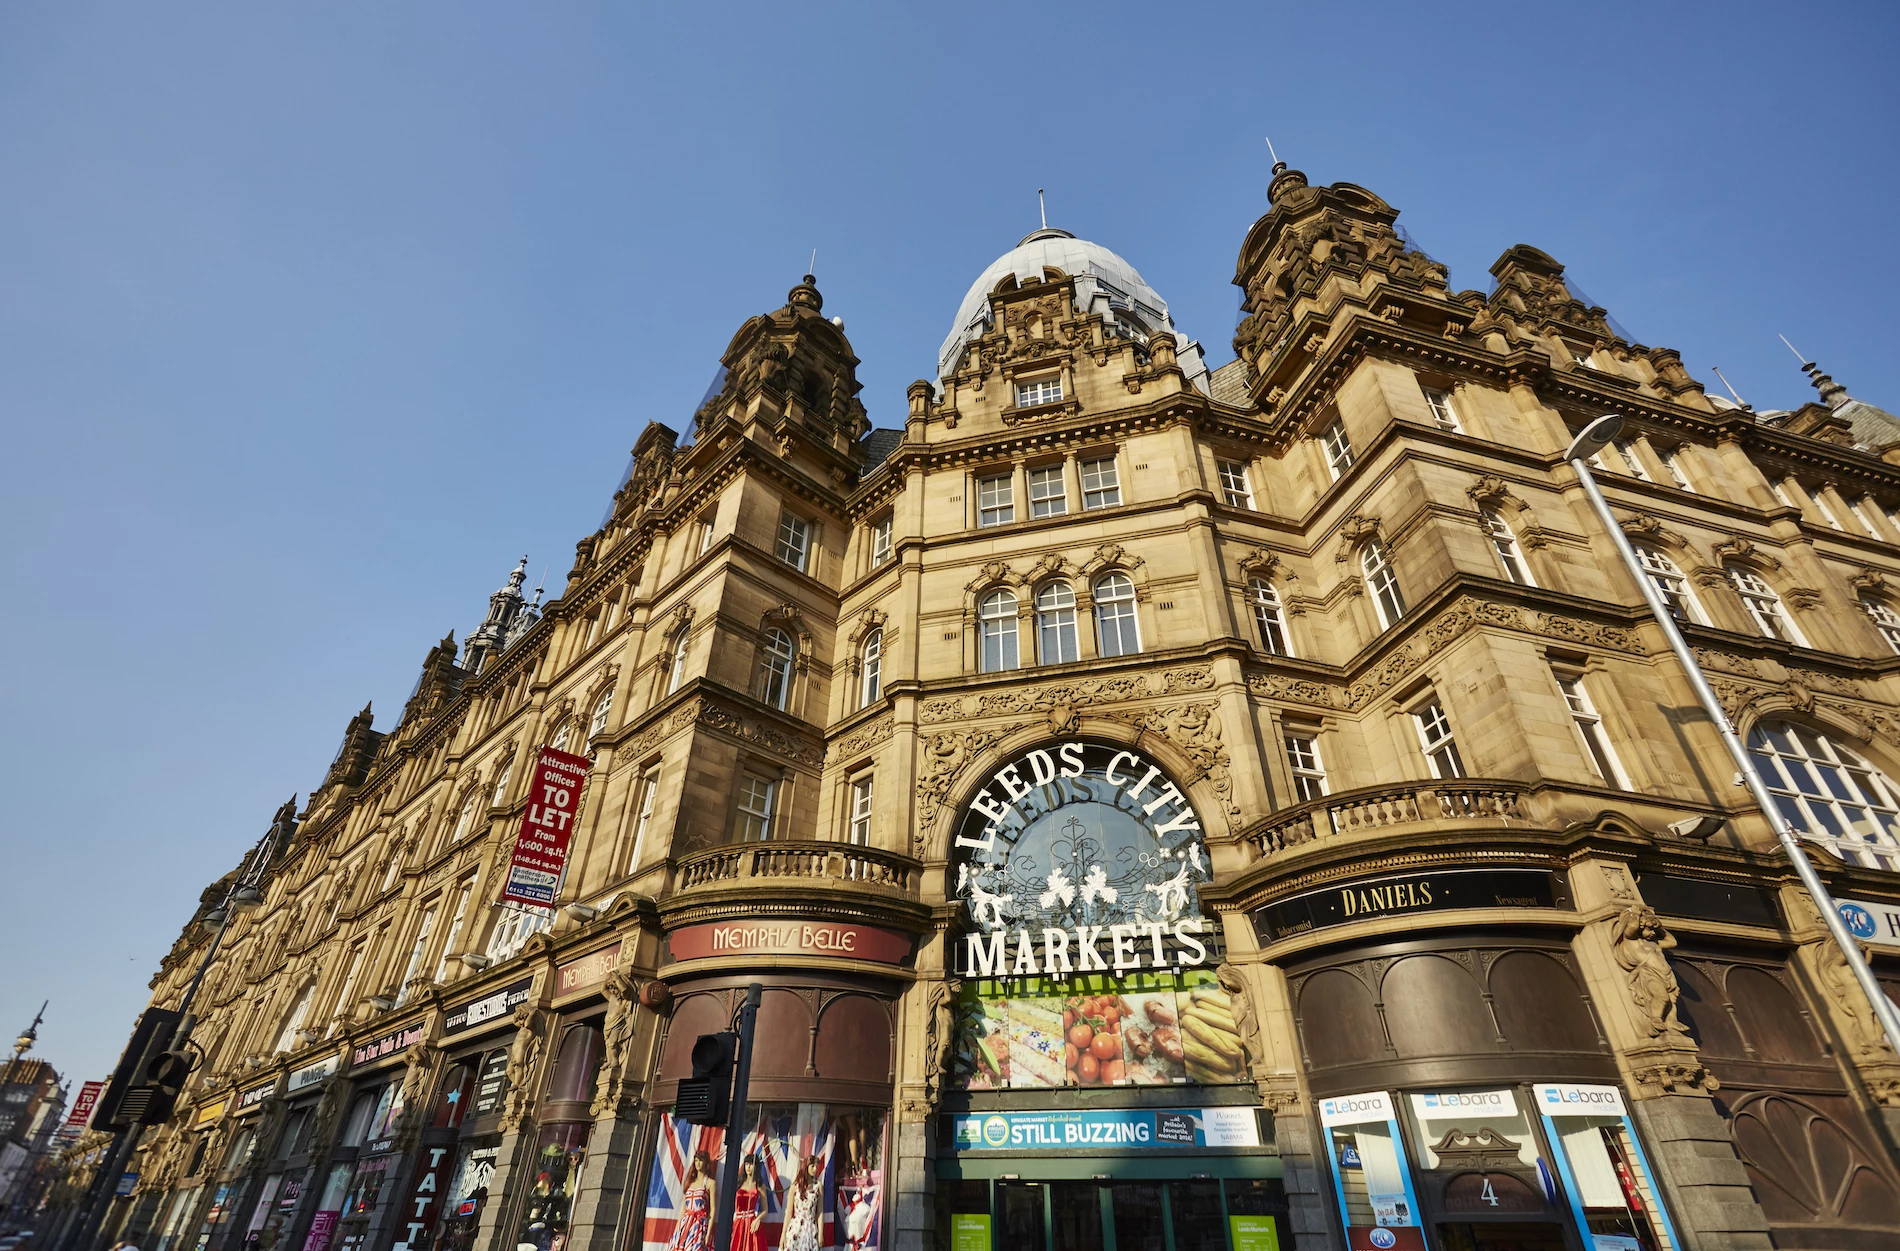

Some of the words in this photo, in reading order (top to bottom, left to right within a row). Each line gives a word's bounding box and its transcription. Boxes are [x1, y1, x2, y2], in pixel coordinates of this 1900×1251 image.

[540, 755, 587, 777] Attractive
[544, 771, 576, 788] Offices
[543, 784, 570, 808] TO
[955, 743, 1085, 852] LEEDS
[1105, 751, 1200, 838] CITY
[528, 803, 571, 831] LET
[534, 829, 556, 843] From
[518, 838, 543, 853] 1,600
[544, 845, 565, 858] sq.ft.
[1341, 882, 1433, 917] DANIELS
[802, 926, 857, 952] BELLE
[965, 919, 1207, 978] MARKETS
[446, 1012, 467, 1029] TATTOO
[1439, 1093, 1502, 1107] Lebara
[1559, 1089, 1615, 1103] Lebara
[1335, 1099, 1382, 1114] Lebara
[1360, 1110, 1384, 1119] mobile
[1474, 1105, 1504, 1113] mobile
[1593, 1104, 1618, 1112] mobile
[1011, 1124, 1061, 1144] STILL
[1065, 1122, 1149, 1143] BUZZING
[1481, 1179, 1499, 1206] 4
